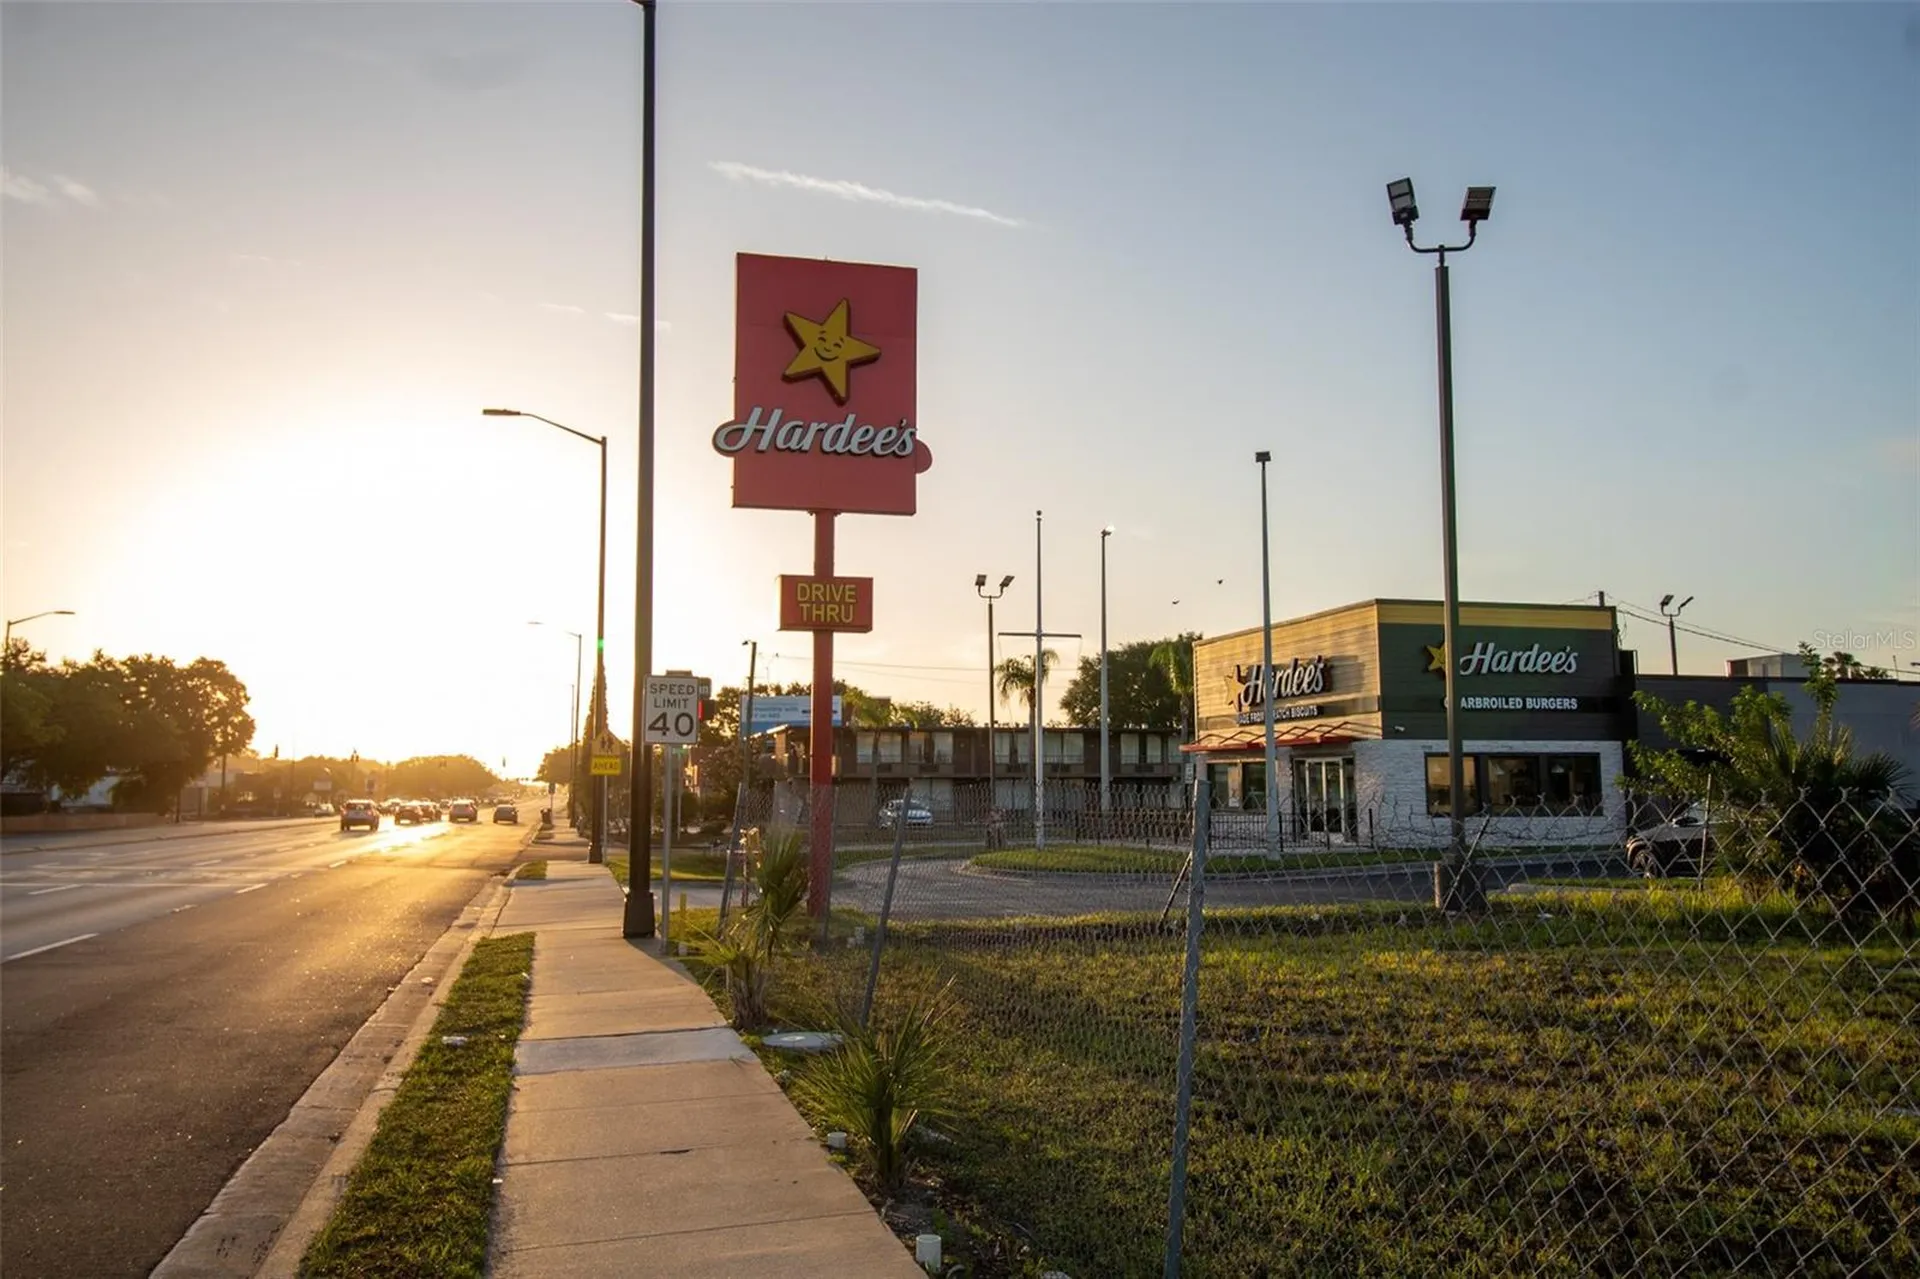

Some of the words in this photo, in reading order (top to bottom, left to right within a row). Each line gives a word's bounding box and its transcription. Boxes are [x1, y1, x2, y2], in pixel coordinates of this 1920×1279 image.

[715, 407, 917, 456] Hardee's
[797, 583, 857, 603] DRIVE
[799, 603, 854, 623] THRU
[1459, 642, 1578, 675] Hardee's
[650, 683, 695, 695] SPEED
[1240, 656, 1325, 706] Hrdee's
[653, 698, 689, 709] LIMIT
[1291, 704, 1318, 718] BISCUITS
[1444, 696, 1523, 709] ARBROILED
[1526, 698, 1578, 710] BURGERS
[648, 712, 694, 737] 40
